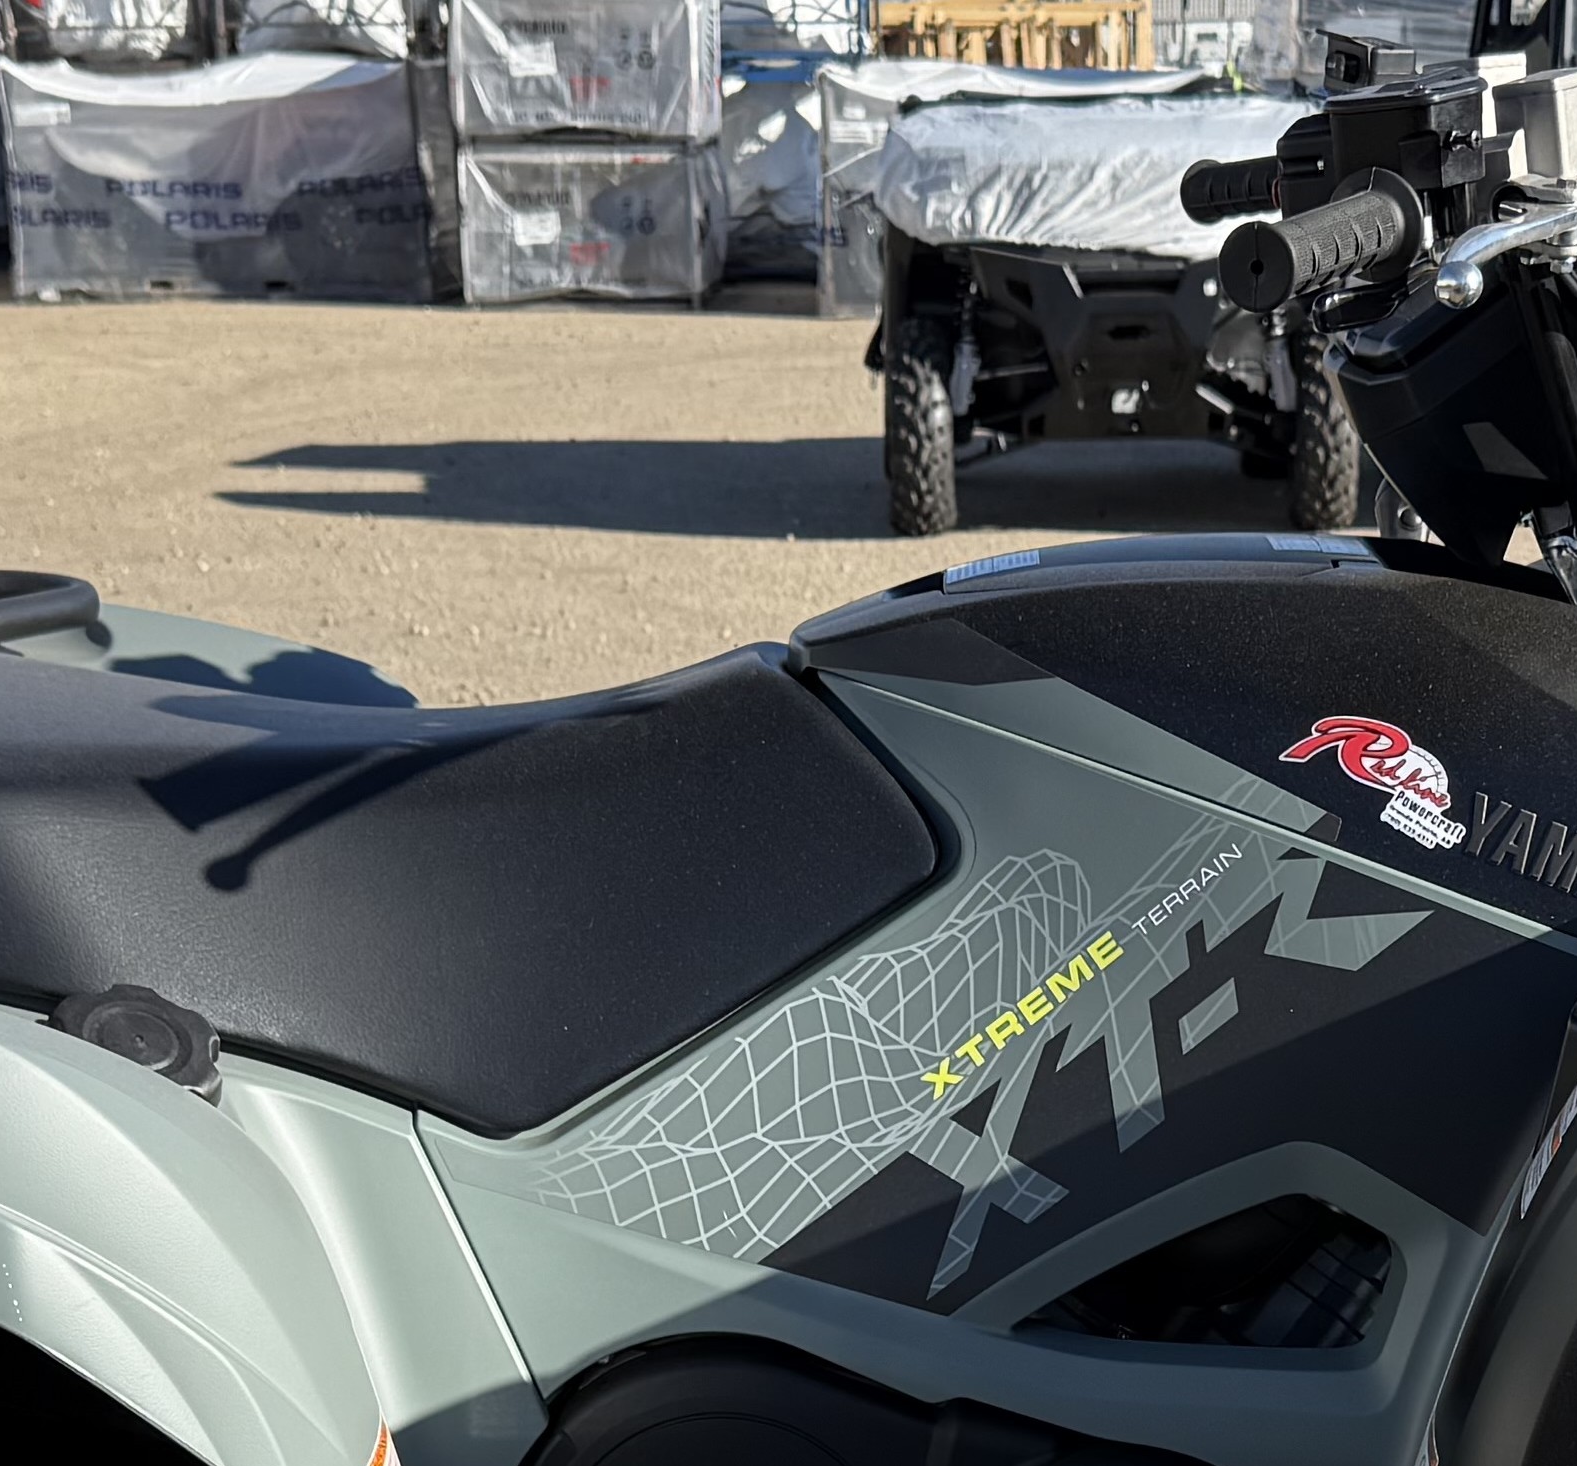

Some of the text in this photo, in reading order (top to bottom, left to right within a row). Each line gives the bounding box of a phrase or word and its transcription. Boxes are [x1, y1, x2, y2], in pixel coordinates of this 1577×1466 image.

[105, 178, 242, 200] POLARIS
[164, 209, 303, 231] POLARIS
[1130, 842, 1244, 936] TERRAIN
[920, 930, 1125, 1101] XTREME
